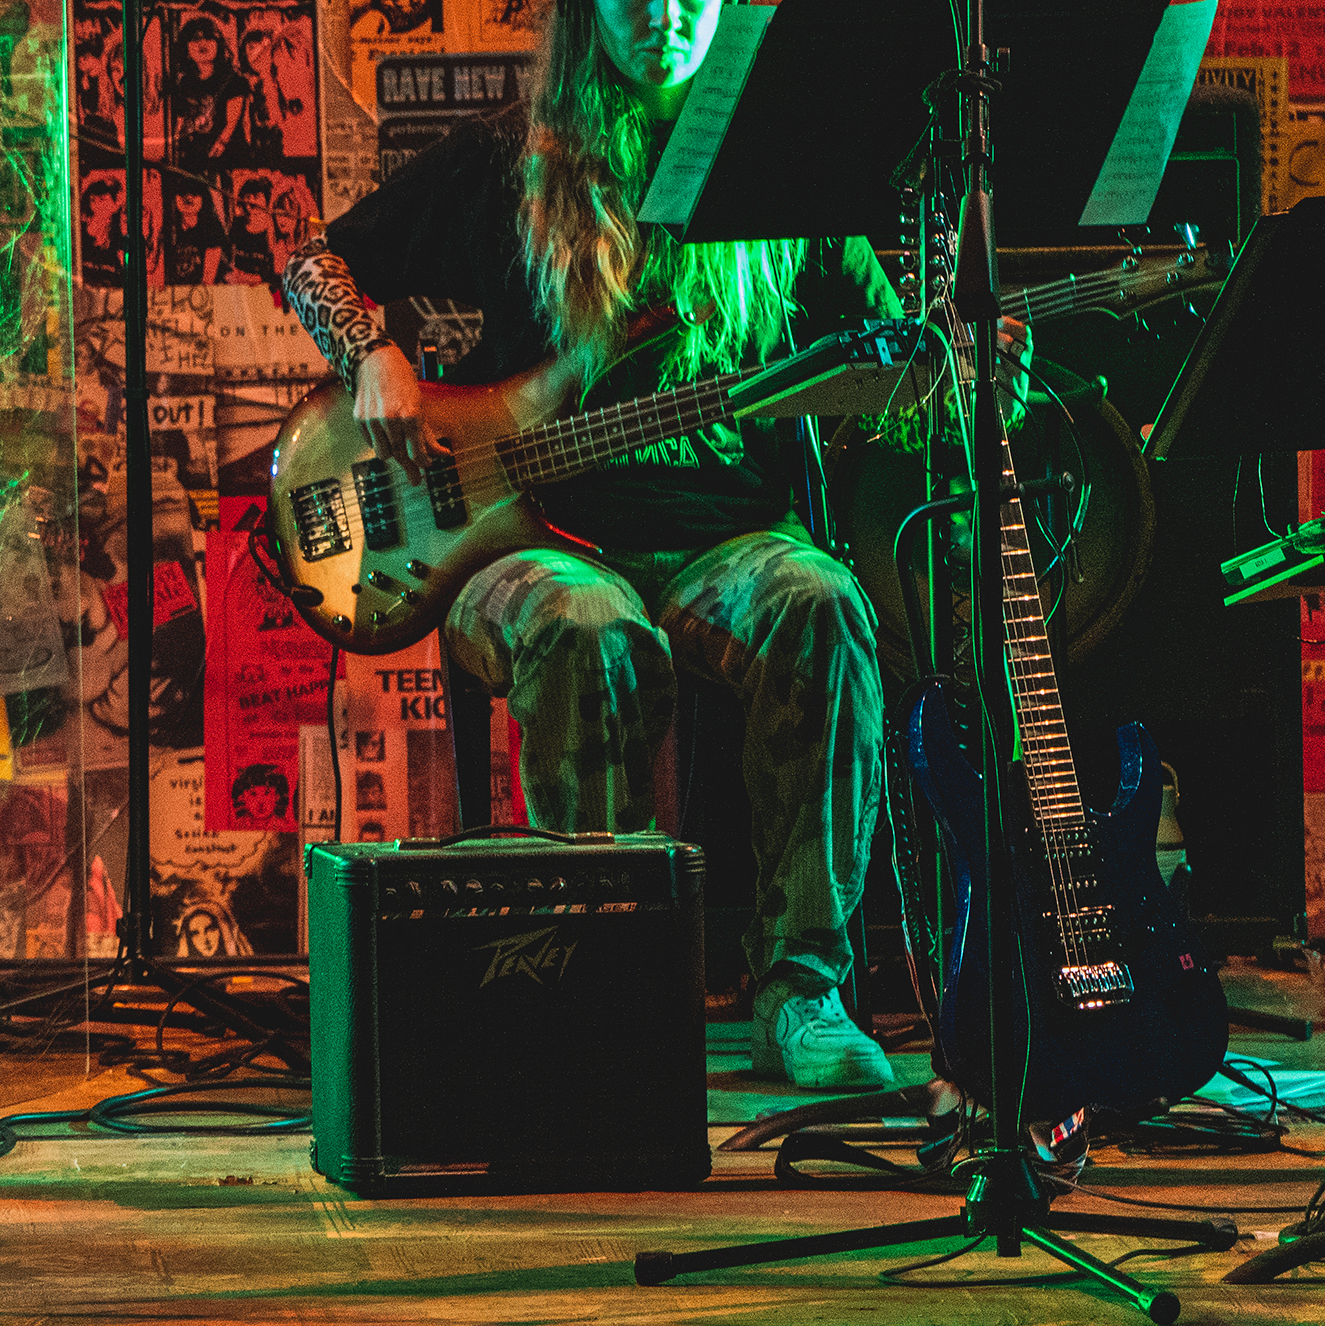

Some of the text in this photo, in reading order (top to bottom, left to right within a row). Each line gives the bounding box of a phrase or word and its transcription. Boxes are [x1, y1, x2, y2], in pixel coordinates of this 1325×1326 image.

[381, 64, 504, 103] RAVE NEW
[153, 402, 208, 426] OUT!
[472, 927, 580, 989] PEAVEY
